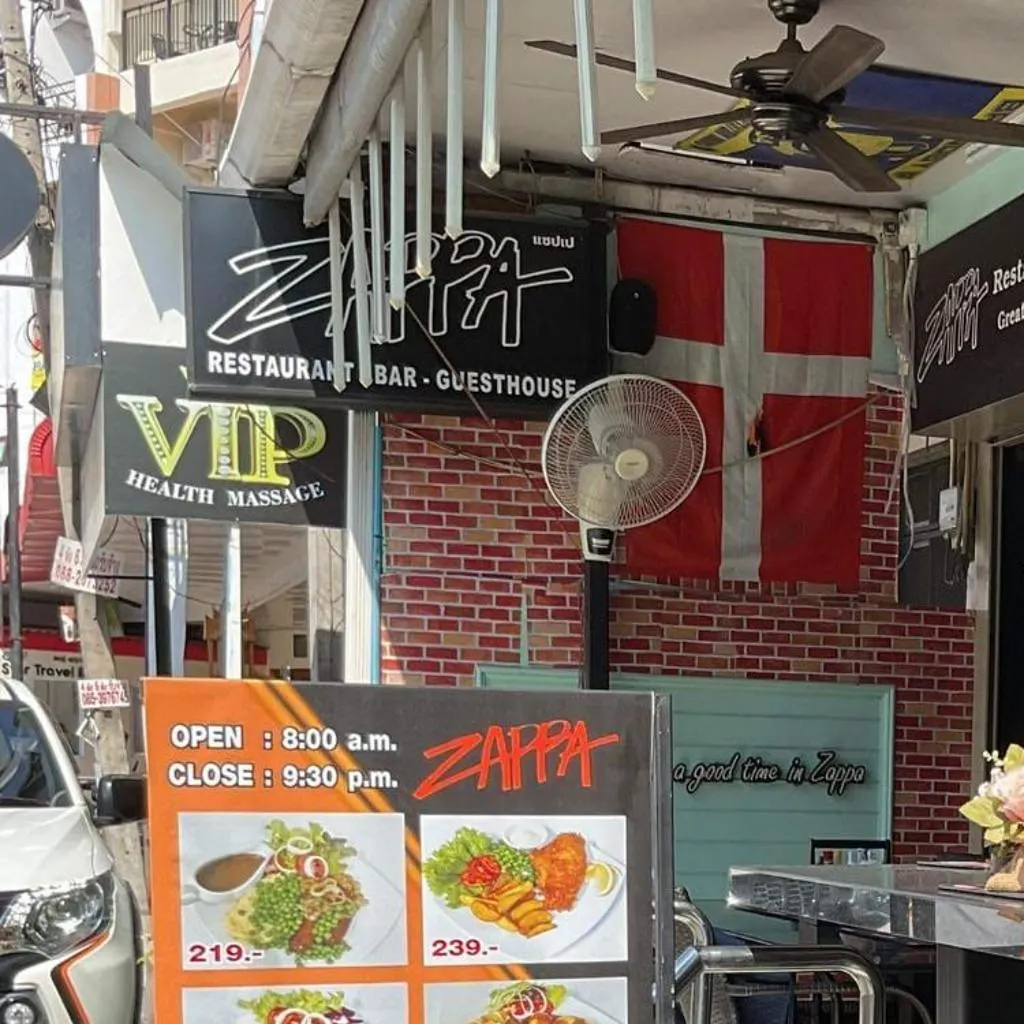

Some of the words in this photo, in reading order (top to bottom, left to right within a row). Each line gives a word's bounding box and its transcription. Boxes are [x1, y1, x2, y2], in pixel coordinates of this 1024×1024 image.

[916, 268, 989, 383] ZAPPA
[374, 363, 417, 389] BAR
[436, 369, 577, 399] GUESTHOUSE
[116, 394, 327, 486] VIP
[125, 469, 214, 506] HEALTH
[227, 481, 326, 509] MASSAGE
[34, 663, 75, 678] Travel
[171, 724, 243, 750] OPEN
[281, 727, 338, 752] 8:00
[347, 732, 398, 753] a.m.
[168, 762, 256, 788] CLOSE
[281, 764, 337, 789] 9:30
[348, 769, 398, 792] p.m.
[412, 718, 620, 800] ZAPPA
[673, 762, 686, 784] a
[686, 750, 741, 794] good
[742, 754, 779, 784] time
[787, 760, 805, 785] in
[809, 750, 866, 795] Zappa
[188, 943, 263, 964] 219.-
[431, 938, 499, 957] 239.-
